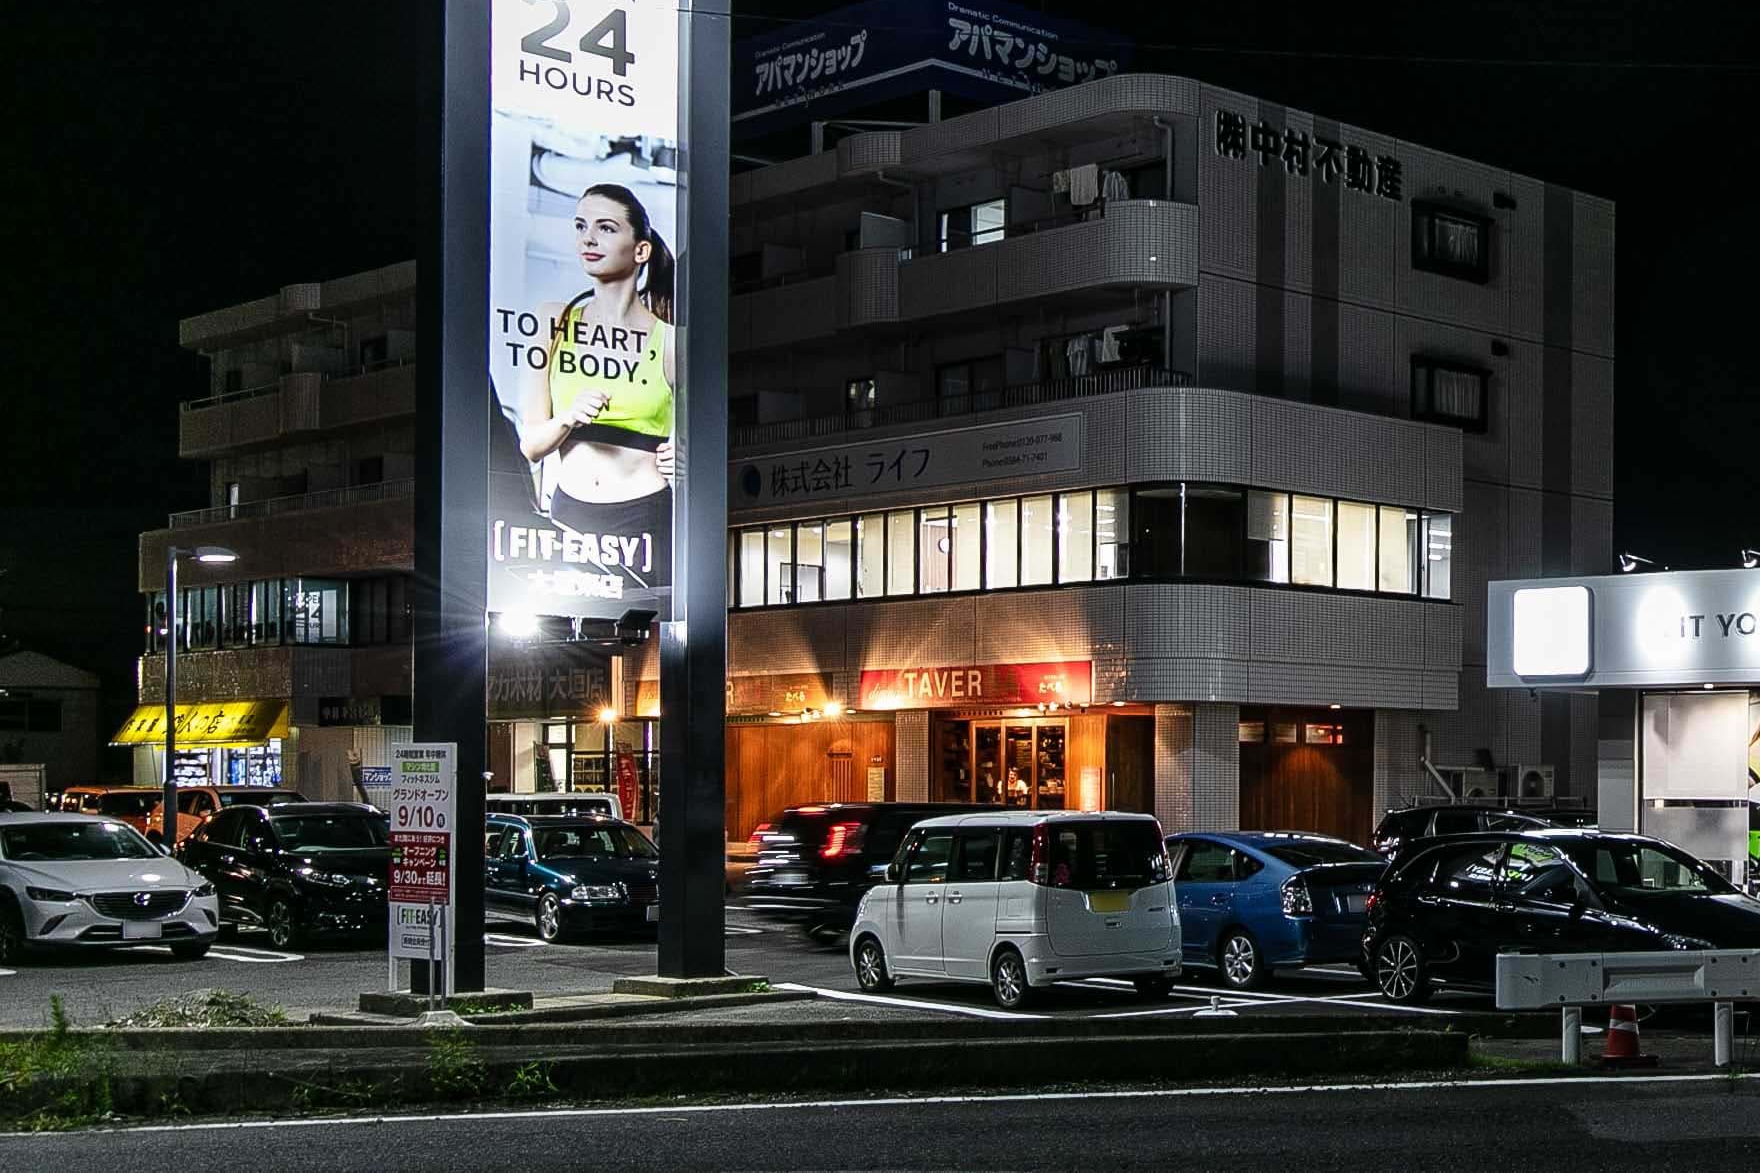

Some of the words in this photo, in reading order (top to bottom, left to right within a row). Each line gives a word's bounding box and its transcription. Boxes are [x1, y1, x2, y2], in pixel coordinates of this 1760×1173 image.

[755, 28, 868, 96] アパマンショップ
[947, 17, 1118, 84] アパマンショップ
[519, 59, 635, 106] HOURS
[496, 308, 539, 336] TO
[550, 316, 657, 361] HEART,
[506, 342, 548, 370] TO
[559, 350, 648, 385] BODY.
[770, 456, 853, 497] 株式会社
[863, 448, 931, 484] ライフ
[903, 669, 983, 699] TAVER
[393, 788, 449, 802] グランドオープン
[402, 846, 437, 857] オープニング
[402, 857, 437, 868] キャンペーン
